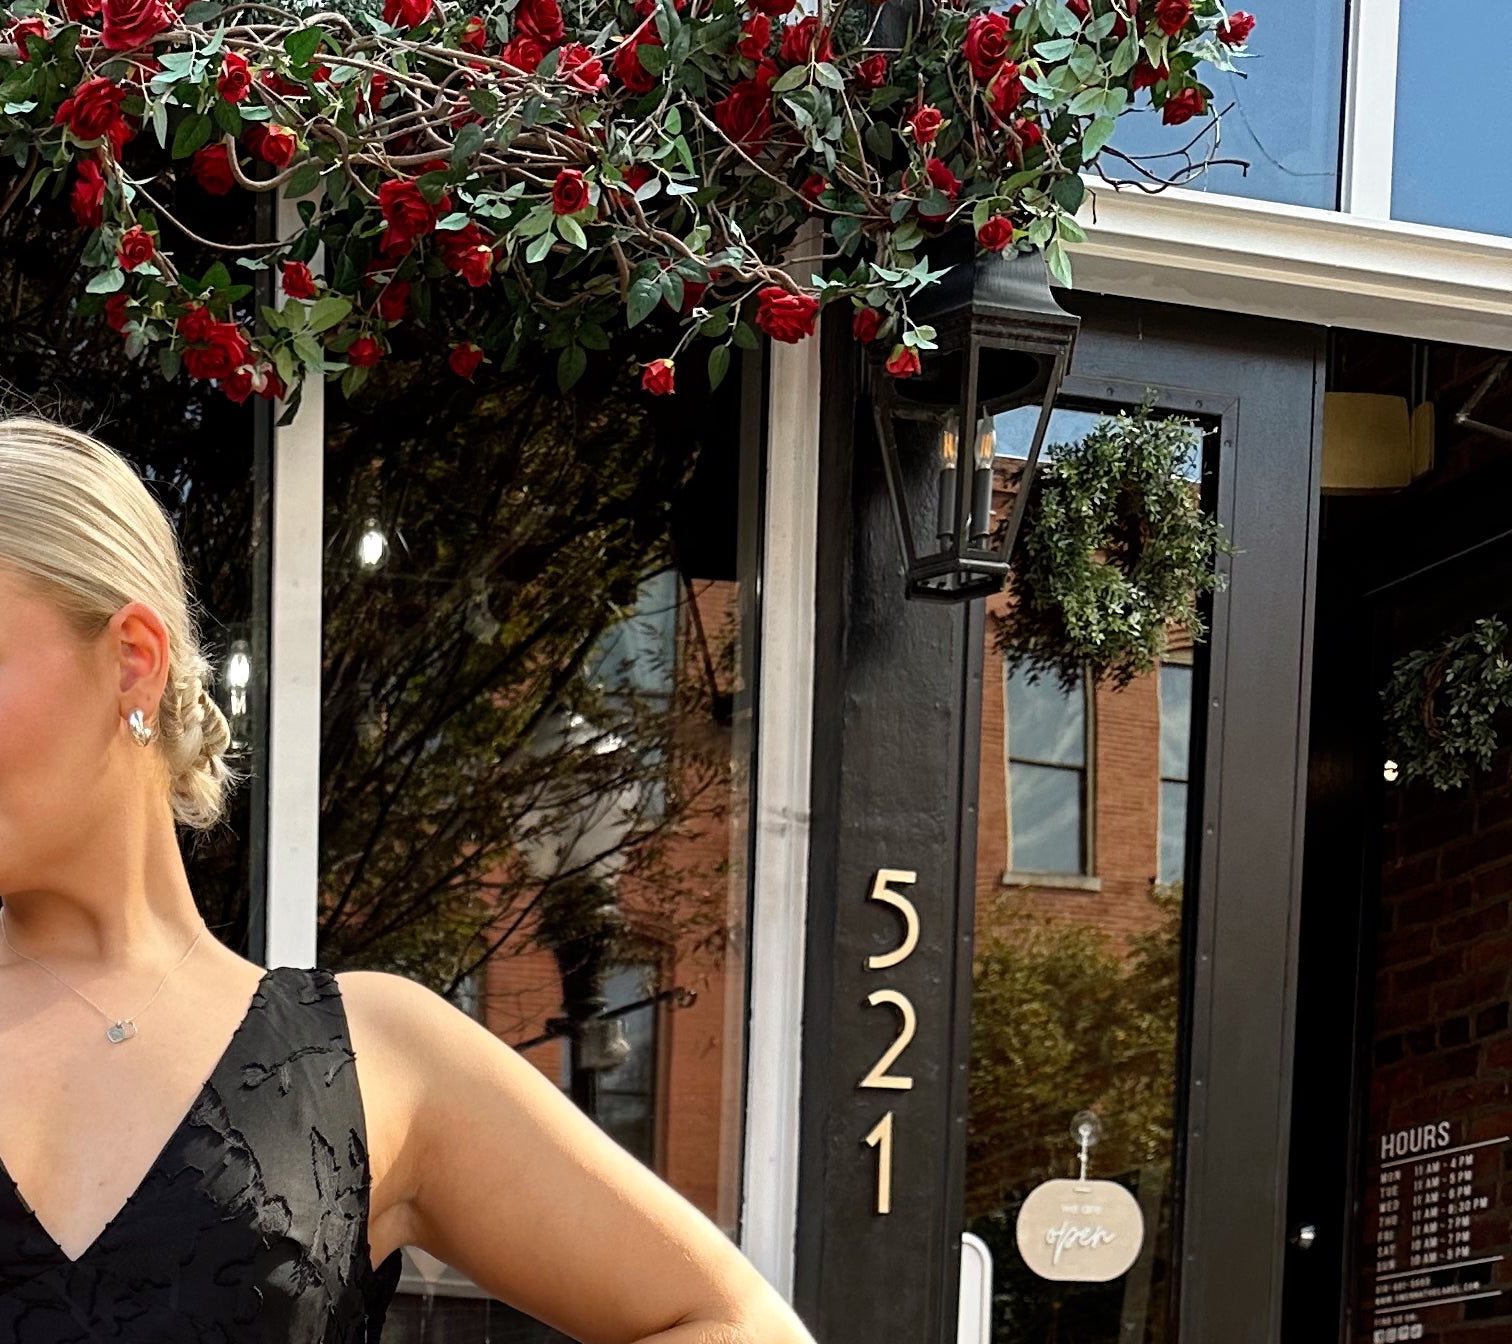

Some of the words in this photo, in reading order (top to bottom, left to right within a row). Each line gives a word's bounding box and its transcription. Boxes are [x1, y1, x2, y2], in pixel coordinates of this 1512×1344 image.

[859, 867, 921, 1215] 521
[1380, 1121, 1451, 1160] HOURS
[1380, 1170, 1402, 1185] MON
[1414, 1165, 1424, 1177] 11
[1425, 1161, 1441, 1173] AM
[1450, 1158, 1457, 1168] 4
[1459, 1154, 1474, 1167] PM
[1380, 1185, 1399, 1199] TUE
[1413, 1180, 1423, 1192] 11
[1425, 1176, 1440, 1189] AM
[1458, 1170, 1473, 1183] PM
[1379, 1199, 1400, 1213] WED
[1413, 1195, 1422, 1207] 11
[1425, 1191, 1439, 1204] AM
[1457, 1185, 1472, 1198] PM
[1379, 1215, 1399, 1228] THU
[1412, 1209, 1422, 1221] 11
[1424, 1206, 1439, 1218] AM
[1473, 1197, 1489, 1210] PM
[1046, 1221, 1116, 1265] open
[1377, 1230, 1395, 1243] FRI
[1412, 1225, 1422, 1237] 11
[1423, 1221, 1438, 1234] AM
[1455, 1215, 1470, 1228] PM
[1377, 1243, 1396, 1258] SAT
[1411, 1239, 1422, 1251] 10
[1423, 1236, 1438, 1249] AM
[1455, 1230, 1471, 1243] PM
[1376, 1258, 1396, 1273] SUN
[1410, 1254, 1421, 1266] 10
[1423, 1251, 1438, 1264] AM
[1455, 1245, 1470, 1258] PM
